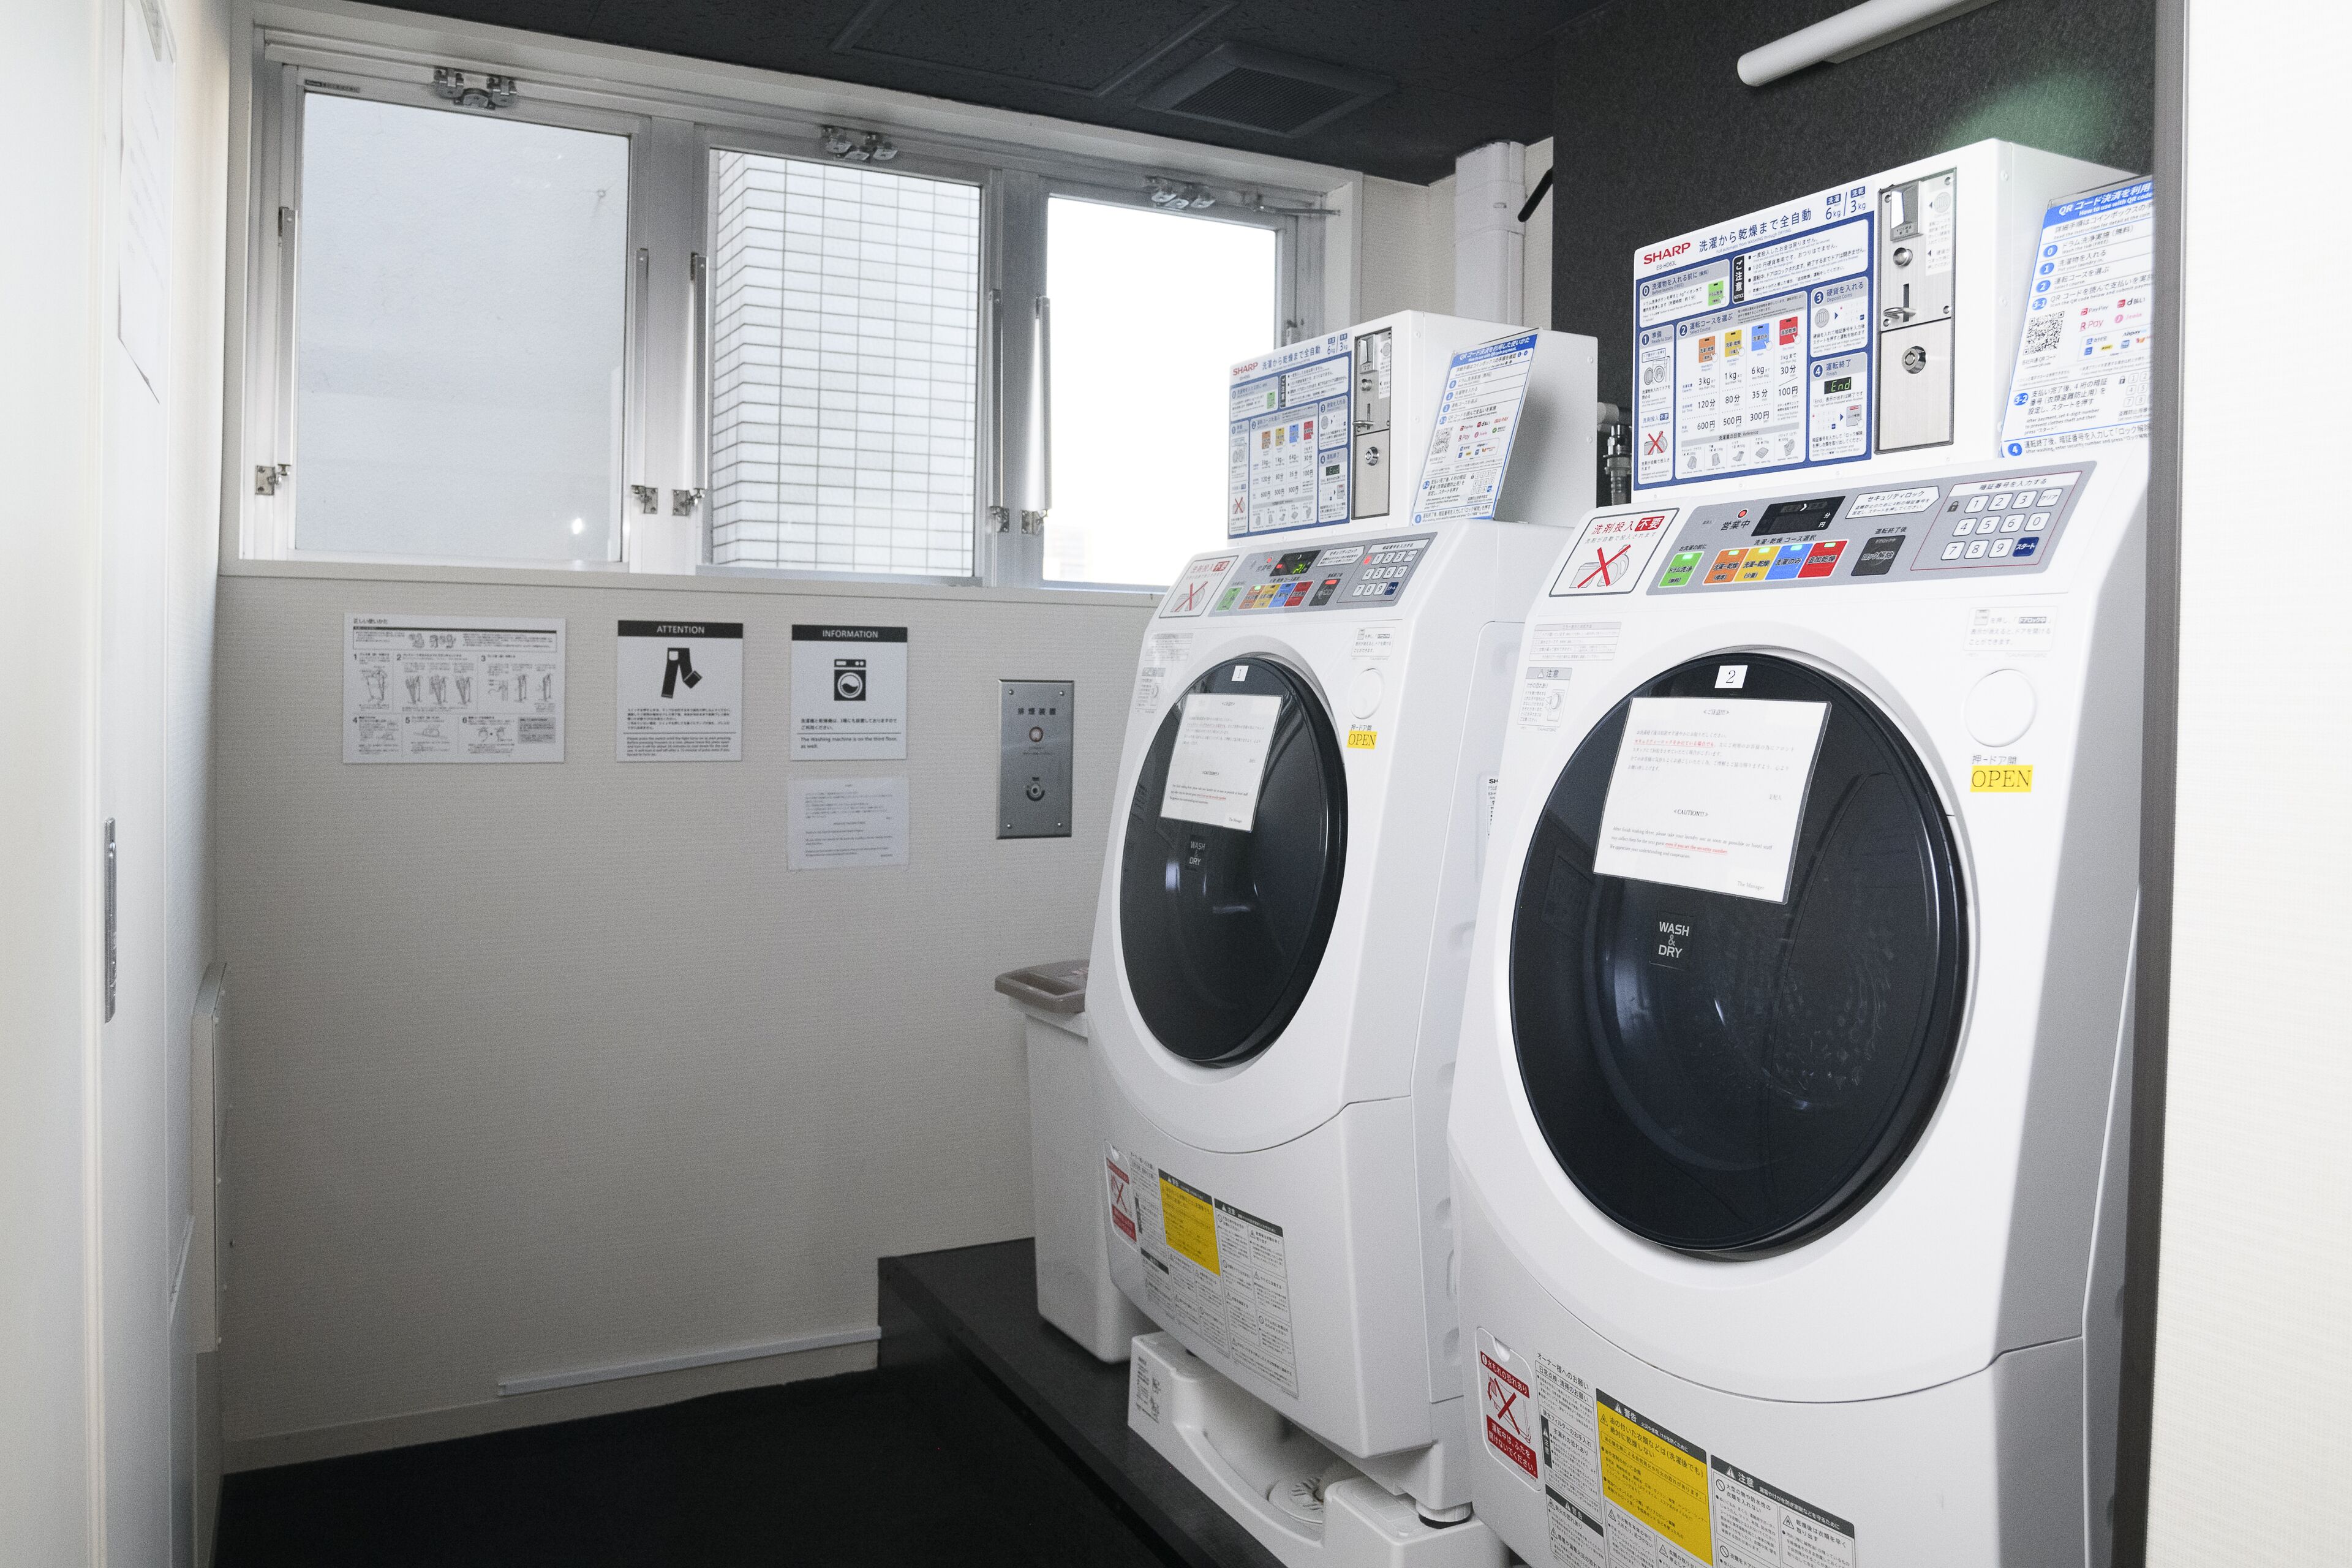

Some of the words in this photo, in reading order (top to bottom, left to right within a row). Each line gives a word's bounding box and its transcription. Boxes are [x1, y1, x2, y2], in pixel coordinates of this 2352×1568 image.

[1699, 208, 1811, 252] 洗濯から乾燥まで全自動
[1643, 243, 1691, 265] SHARP
[2054, 266, 2109, 284] 運転コースを選ぶ
[1826, 281, 1863, 296] 硬貨を入れる
[1690, 312, 1733, 331] 運転コースを選ぶ
[2088, 319, 2104, 328] Pay
[1262, 345, 1321, 370] 洗濯から乾燥まで全自動
[1233, 362, 1258, 375] SHARP
[1752, 366, 1764, 375] 6kg
[1781, 365, 1796, 375] 30分
[1826, 359, 1850, 371] 運転終了
[1725, 372, 1736, 380] 1kg
[1779, 386, 1798, 396] 100円
[1831, 379, 1850, 393] End
[1725, 394, 1740, 404] 80分
[1752, 389, 1768, 399] 35分
[2014, 394, 2028, 404] 3-2
[1698, 399, 1715, 409] 120分
[1723, 415, 1741, 426] 500円
[1750, 411, 1769, 421] 300円
[1697, 420, 1715, 430] 600円
[1979, 478, 2047, 491] 暗証番号を入力する
[1868, 491, 1924, 502] セキュリティロック
[2019, 496, 2026, 504] 3
[1591, 521, 1634, 535] 洗剤投入
[1638, 518, 1662, 530] 不要
[1721, 521, 1750, 531] 営業中
[1960, 522, 1967, 531] 4
[1983, 521, 1990, 529] 5
[2008, 519, 2015, 527] 6
[2034, 517, 2040, 526] 0
[1951, 546, 1957, 555] 7
[1972, 545, 1980, 553] 8
[1997, 543, 2003, 552] 9
[1807, 555, 1836, 564] 追加乾燥
[1862, 551, 1894, 560] ロック解除
[657, 625, 705, 634] ATTENTION
[823, 630, 879, 639] INFORMATION
[1726, 670, 1736, 684] 2
[1348, 734, 1376, 746] OPEN
[1972, 771, 2031, 787] OPEN
[1190, 841, 1205, 850] WASH
[1189, 858, 1200, 866] DRY
[1659, 921, 1689, 937] WASH
[1668, 934, 1675, 946] &
[1658, 944, 1683, 959] DRY
[1487, 1360, 1528, 1394] 水もれの恐れあり
[1624, 1408, 1637, 1422] 警告
[1491, 1422, 1531, 1458] 運転中は、ふたを
[1610, 1426, 1654, 1457] 絶対に乾燥しない
[1738, 1472, 1754, 1488] 注意
[1726, 1484, 1771, 1510] 大型の物や防水性の
[1727, 1491, 1762, 1513] 衣類を入れない
[1796, 1518, 1846, 1548] 乾燥後は衣類を早く
[1796, 1527, 1818, 1542] 取り出す
